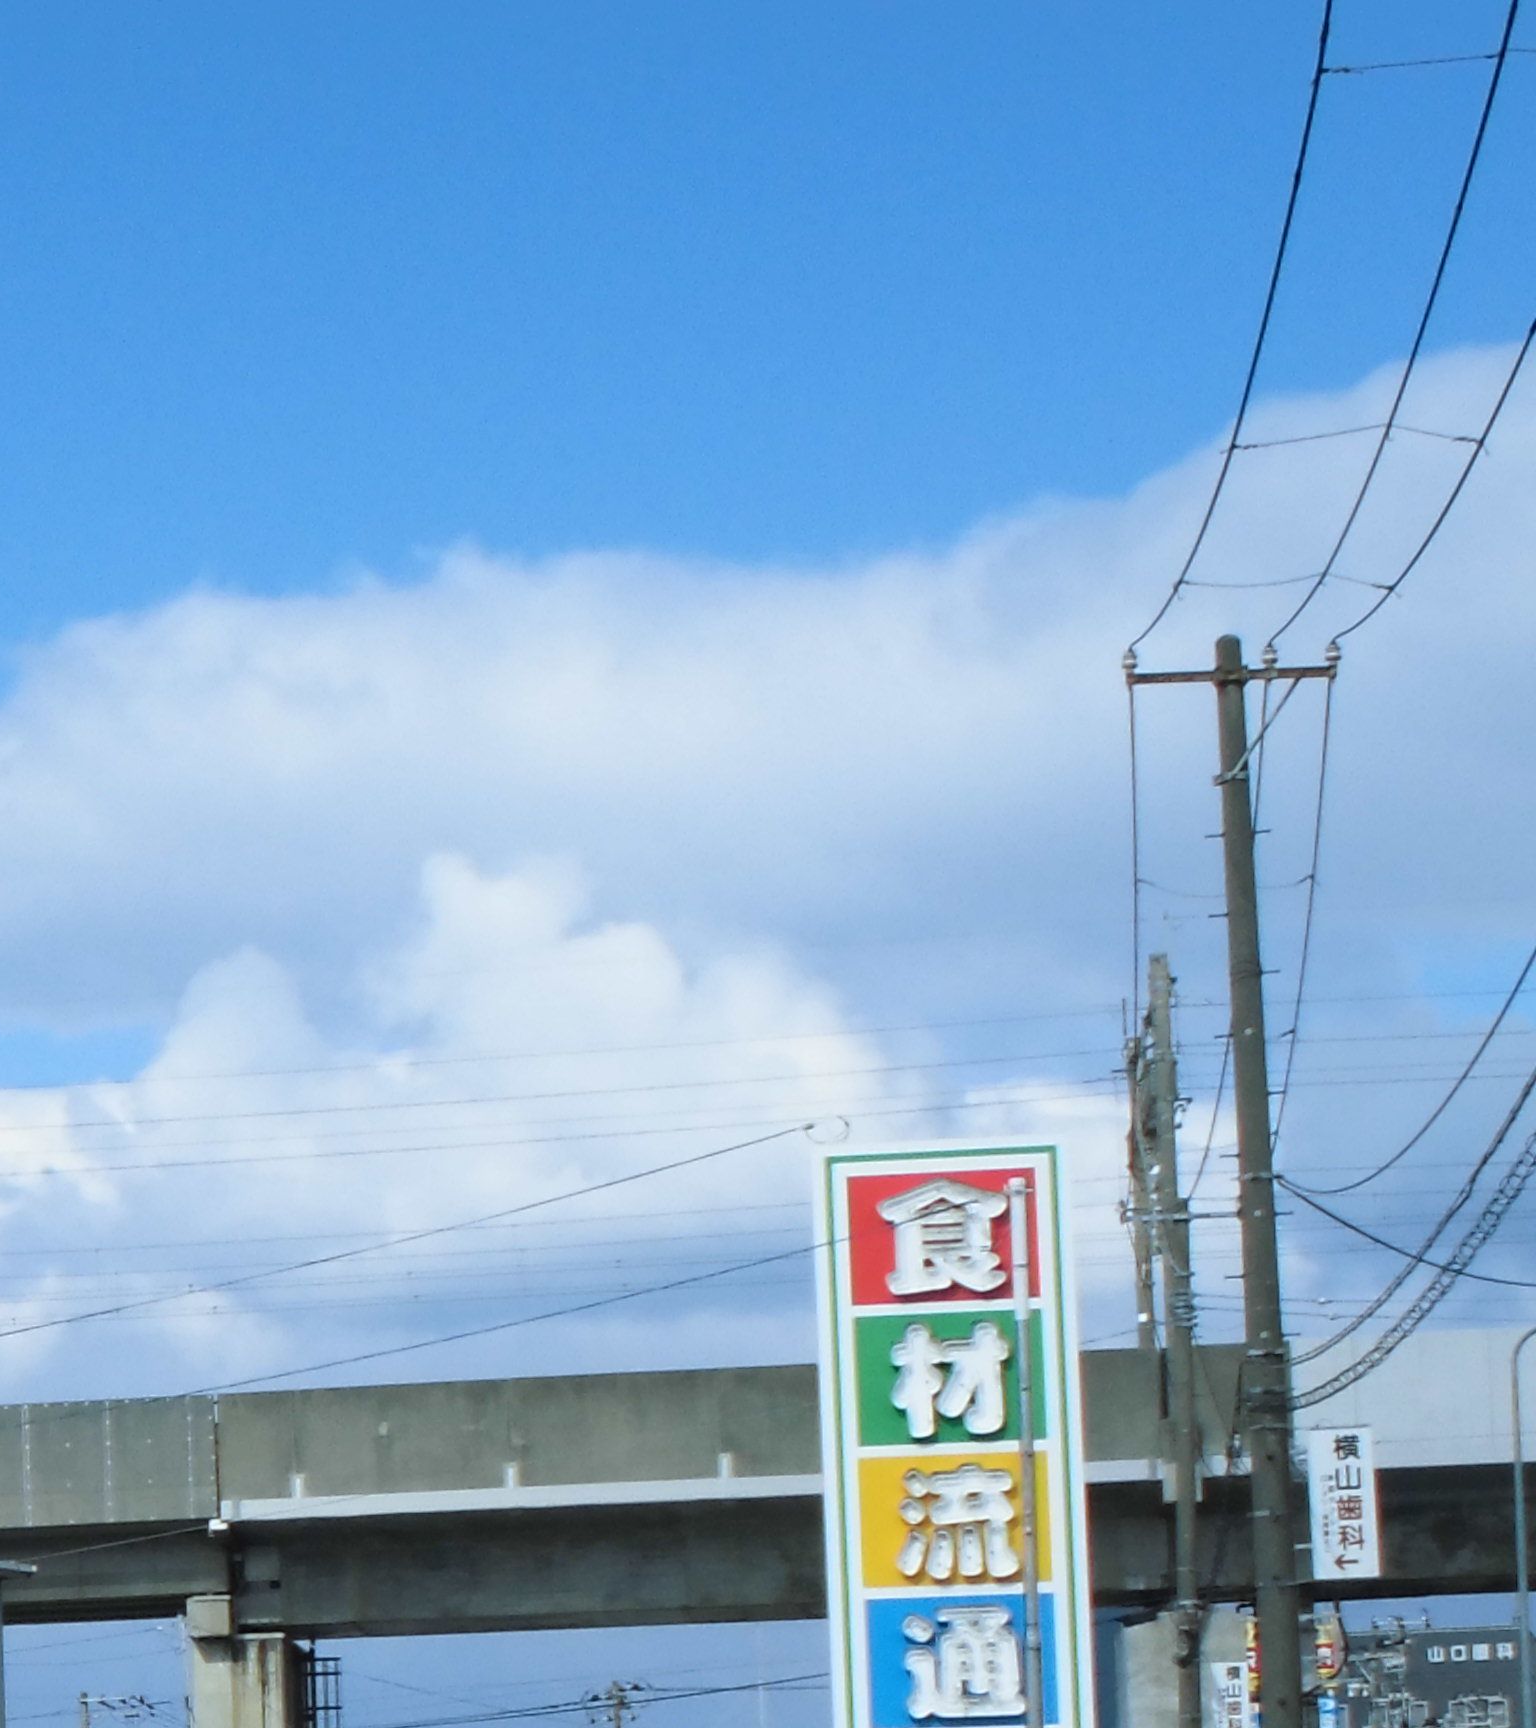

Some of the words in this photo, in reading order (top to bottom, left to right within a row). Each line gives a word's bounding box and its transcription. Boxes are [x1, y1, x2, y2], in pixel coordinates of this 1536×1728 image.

[876, 1178, 1026, 1720] 食材流通
[1333, 1435, 1364, 1551] 横山歯科
